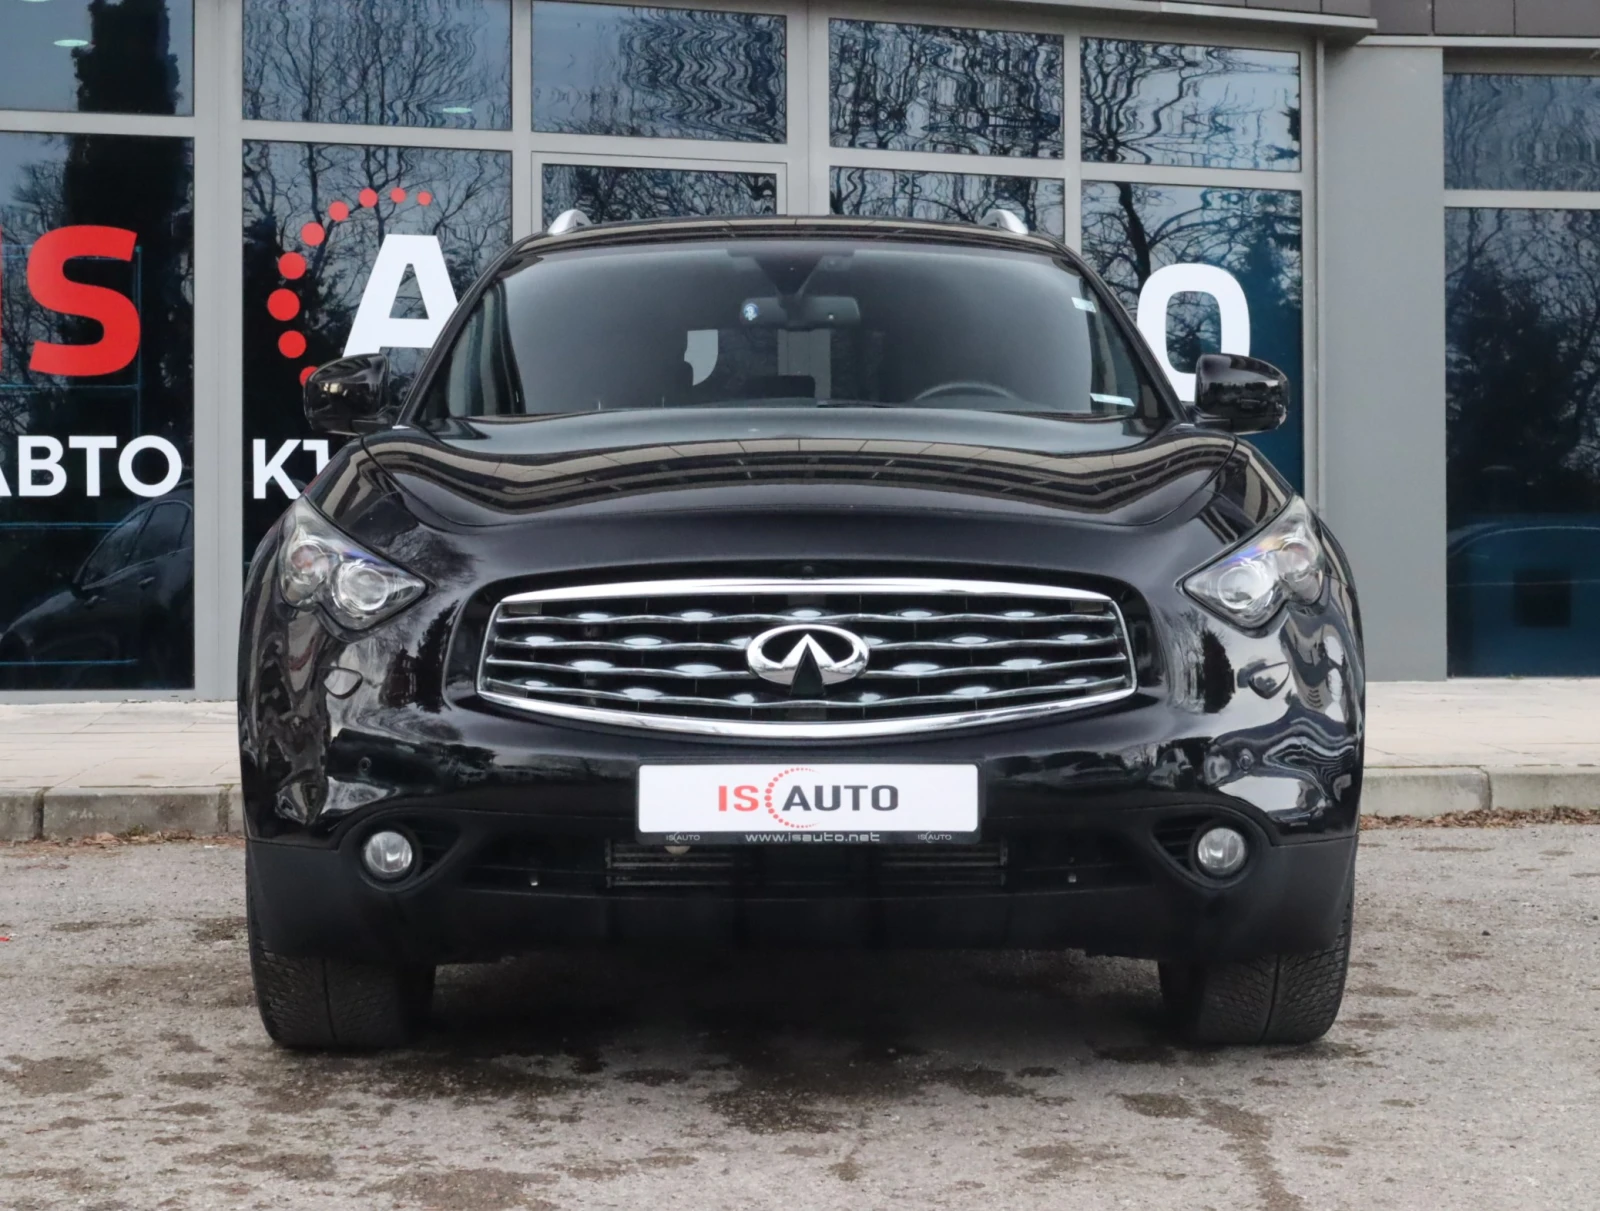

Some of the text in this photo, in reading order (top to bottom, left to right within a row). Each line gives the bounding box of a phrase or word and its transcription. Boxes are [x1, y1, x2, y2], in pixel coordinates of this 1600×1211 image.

[0, 224, 141, 377] S
[0, 434, 182, 498] ВТО
[782, 784, 899, 811] AUTO
[745, 832, 880, 842] www.isauto.net
